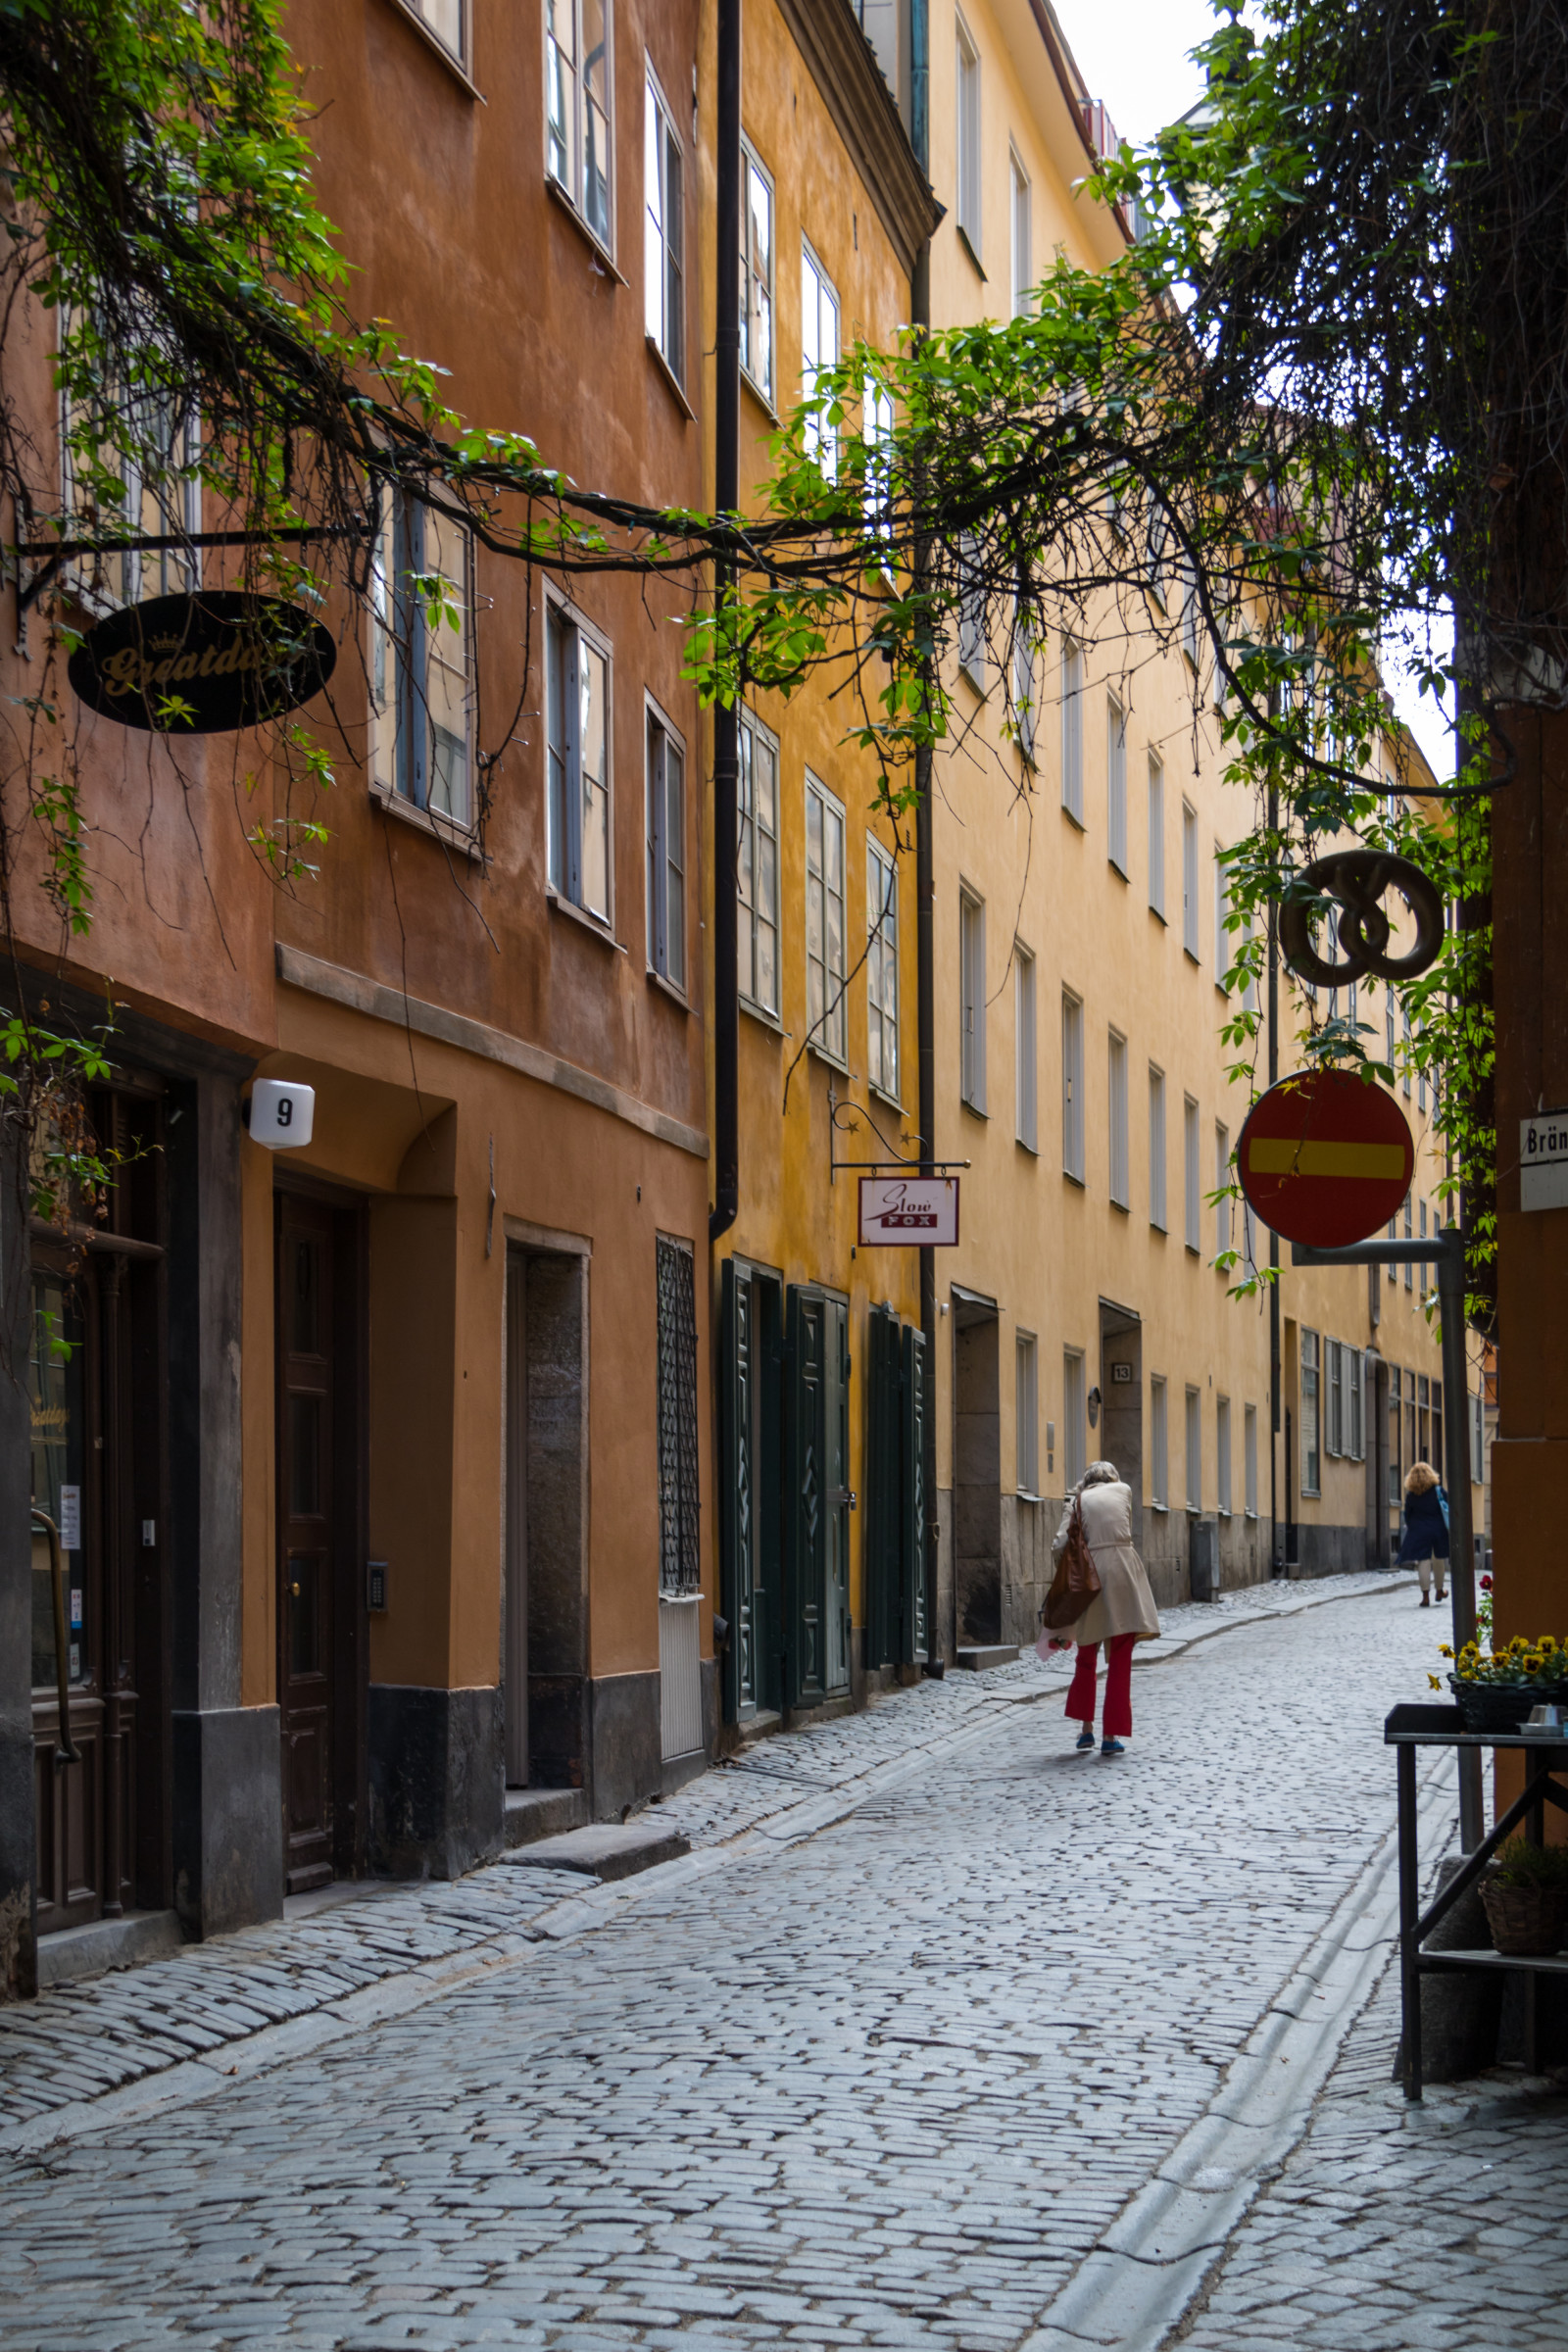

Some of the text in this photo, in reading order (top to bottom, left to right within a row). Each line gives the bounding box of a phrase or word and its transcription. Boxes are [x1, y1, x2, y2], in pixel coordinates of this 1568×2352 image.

[276, 1098, 293, 1127] 9
[1528, 1126, 1568, 1154] Brän
[863, 1183, 931, 1221] Slow
[888, 1216, 930, 1226] FOX
[1115, 1367, 1129, 1379] 13
